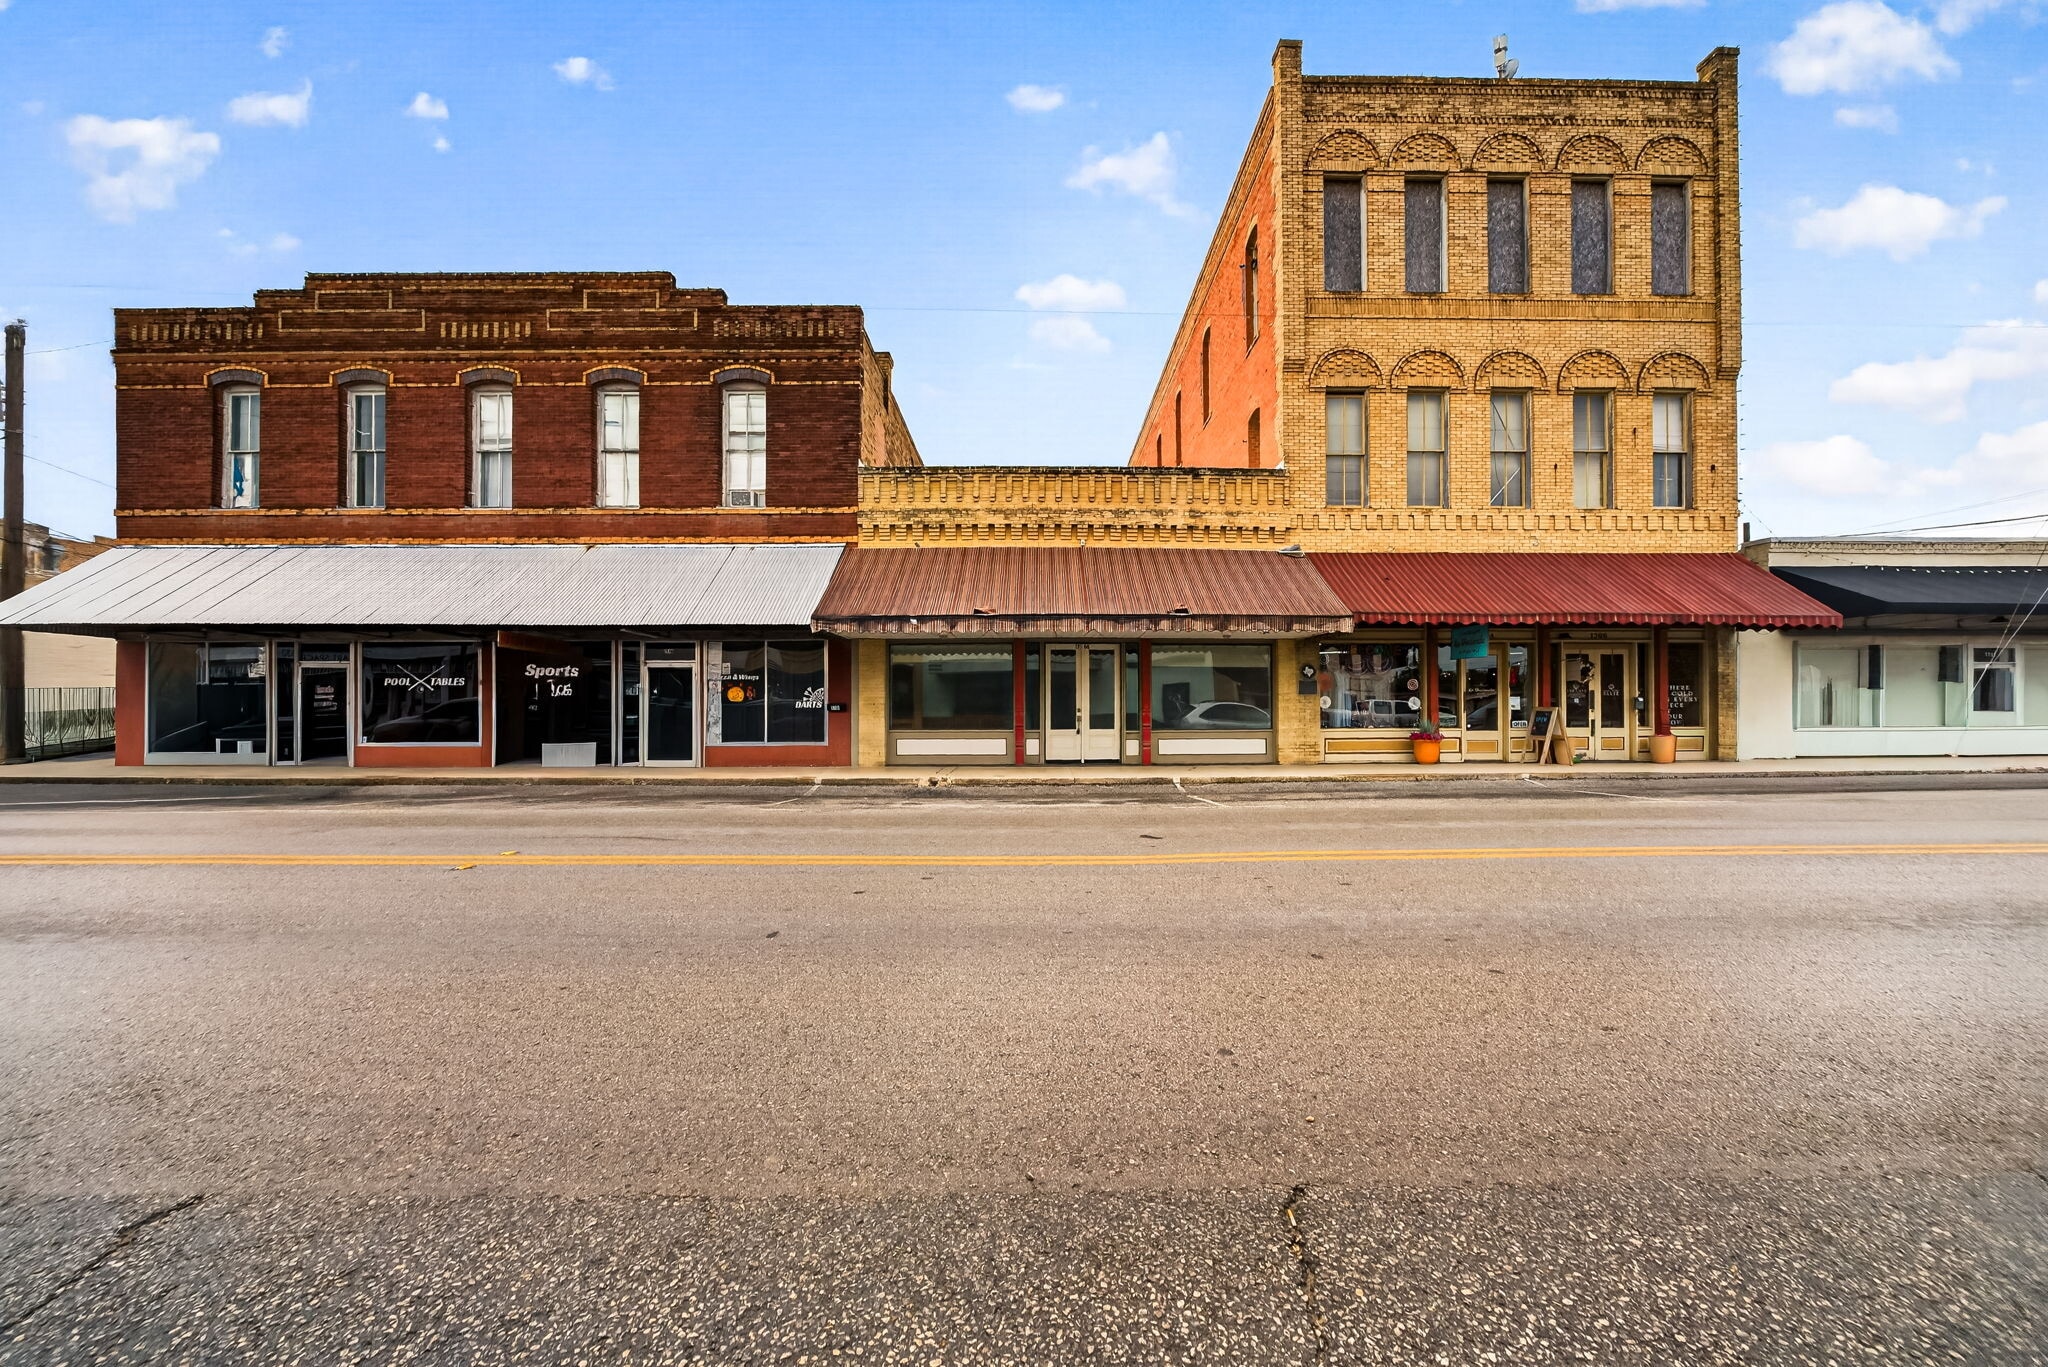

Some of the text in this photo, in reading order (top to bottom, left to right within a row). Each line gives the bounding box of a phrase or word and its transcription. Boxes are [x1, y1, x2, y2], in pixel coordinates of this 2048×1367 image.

[524, 663, 580, 679] Sports
[384, 677, 466, 686] POOL TABLES
[795, 701, 823, 709] DARTS
